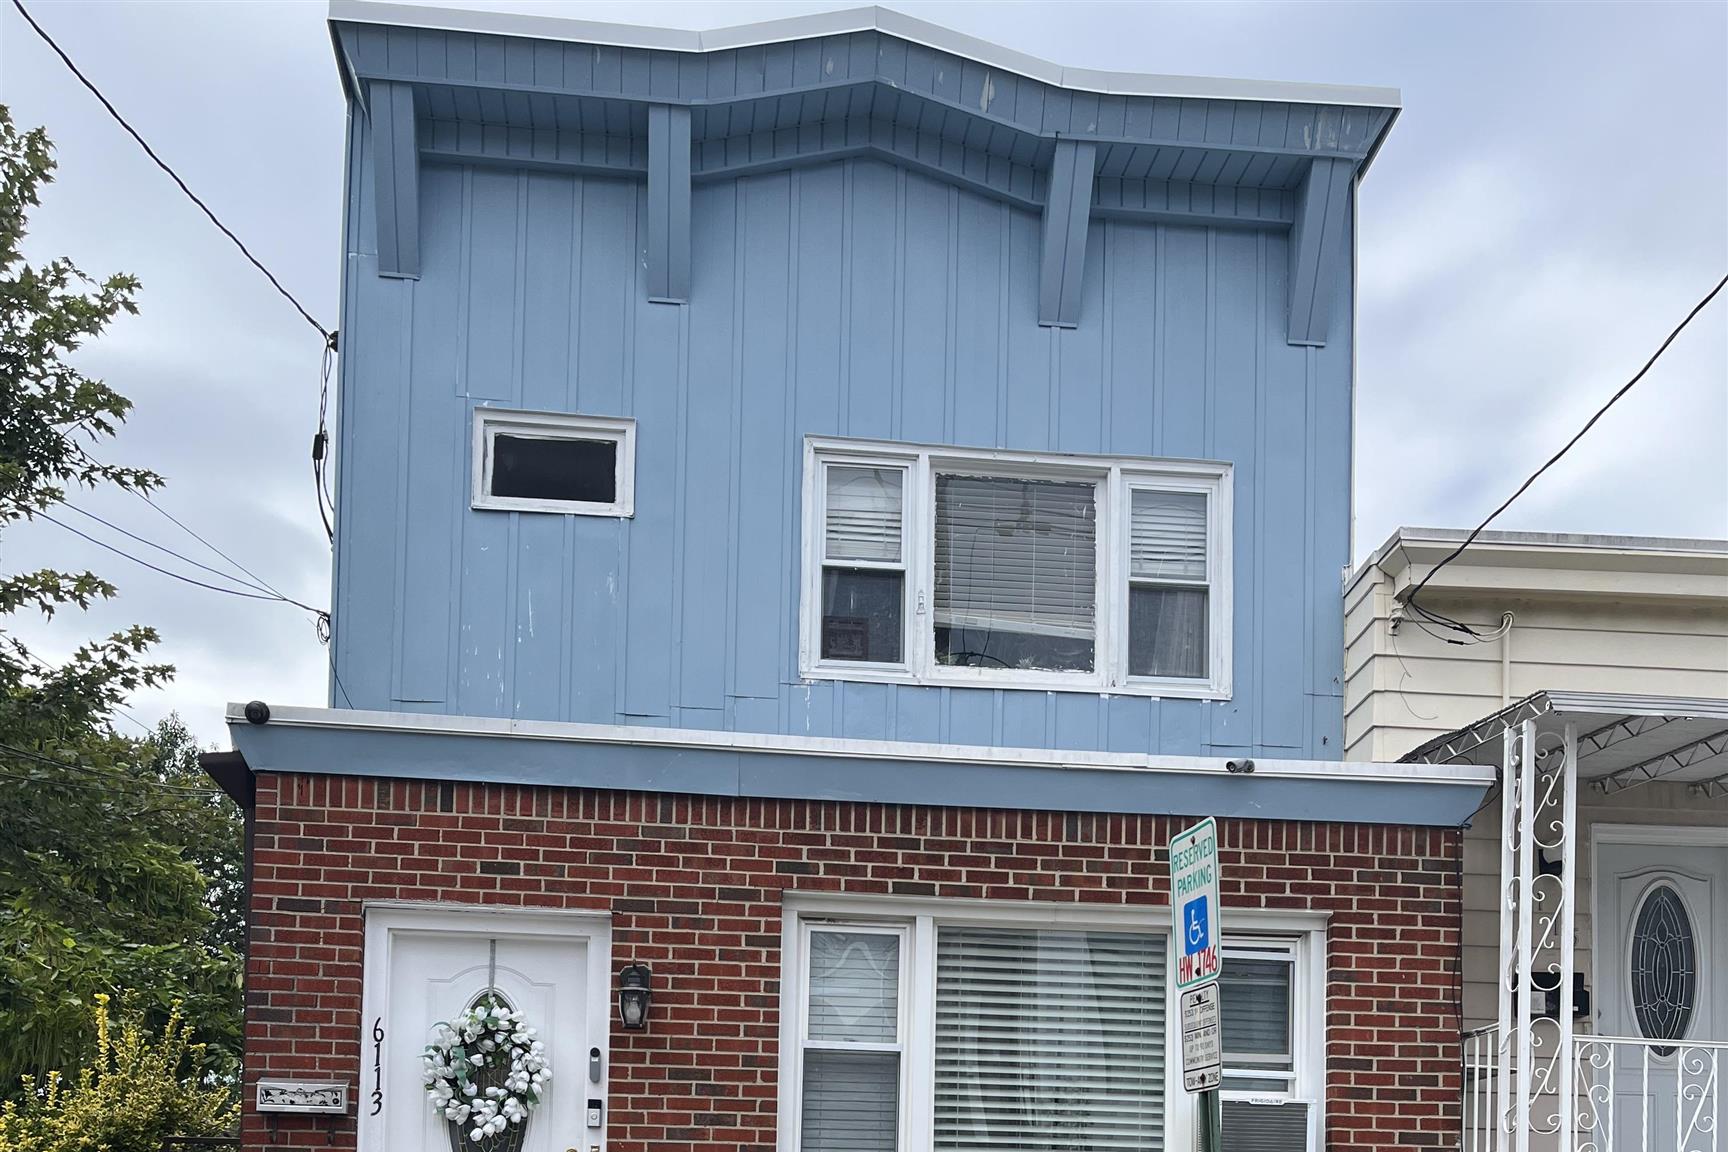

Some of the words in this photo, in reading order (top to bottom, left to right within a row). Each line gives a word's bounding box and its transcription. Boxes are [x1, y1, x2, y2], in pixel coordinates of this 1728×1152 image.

[1173, 836, 1213, 873] RESERVED
[1177, 864, 1212, 897] PARKING
[1179, 954, 1193, 984] HW
[1197, 944, 1217, 977] 1746
[370, 1016, 385, 1117] 6113
